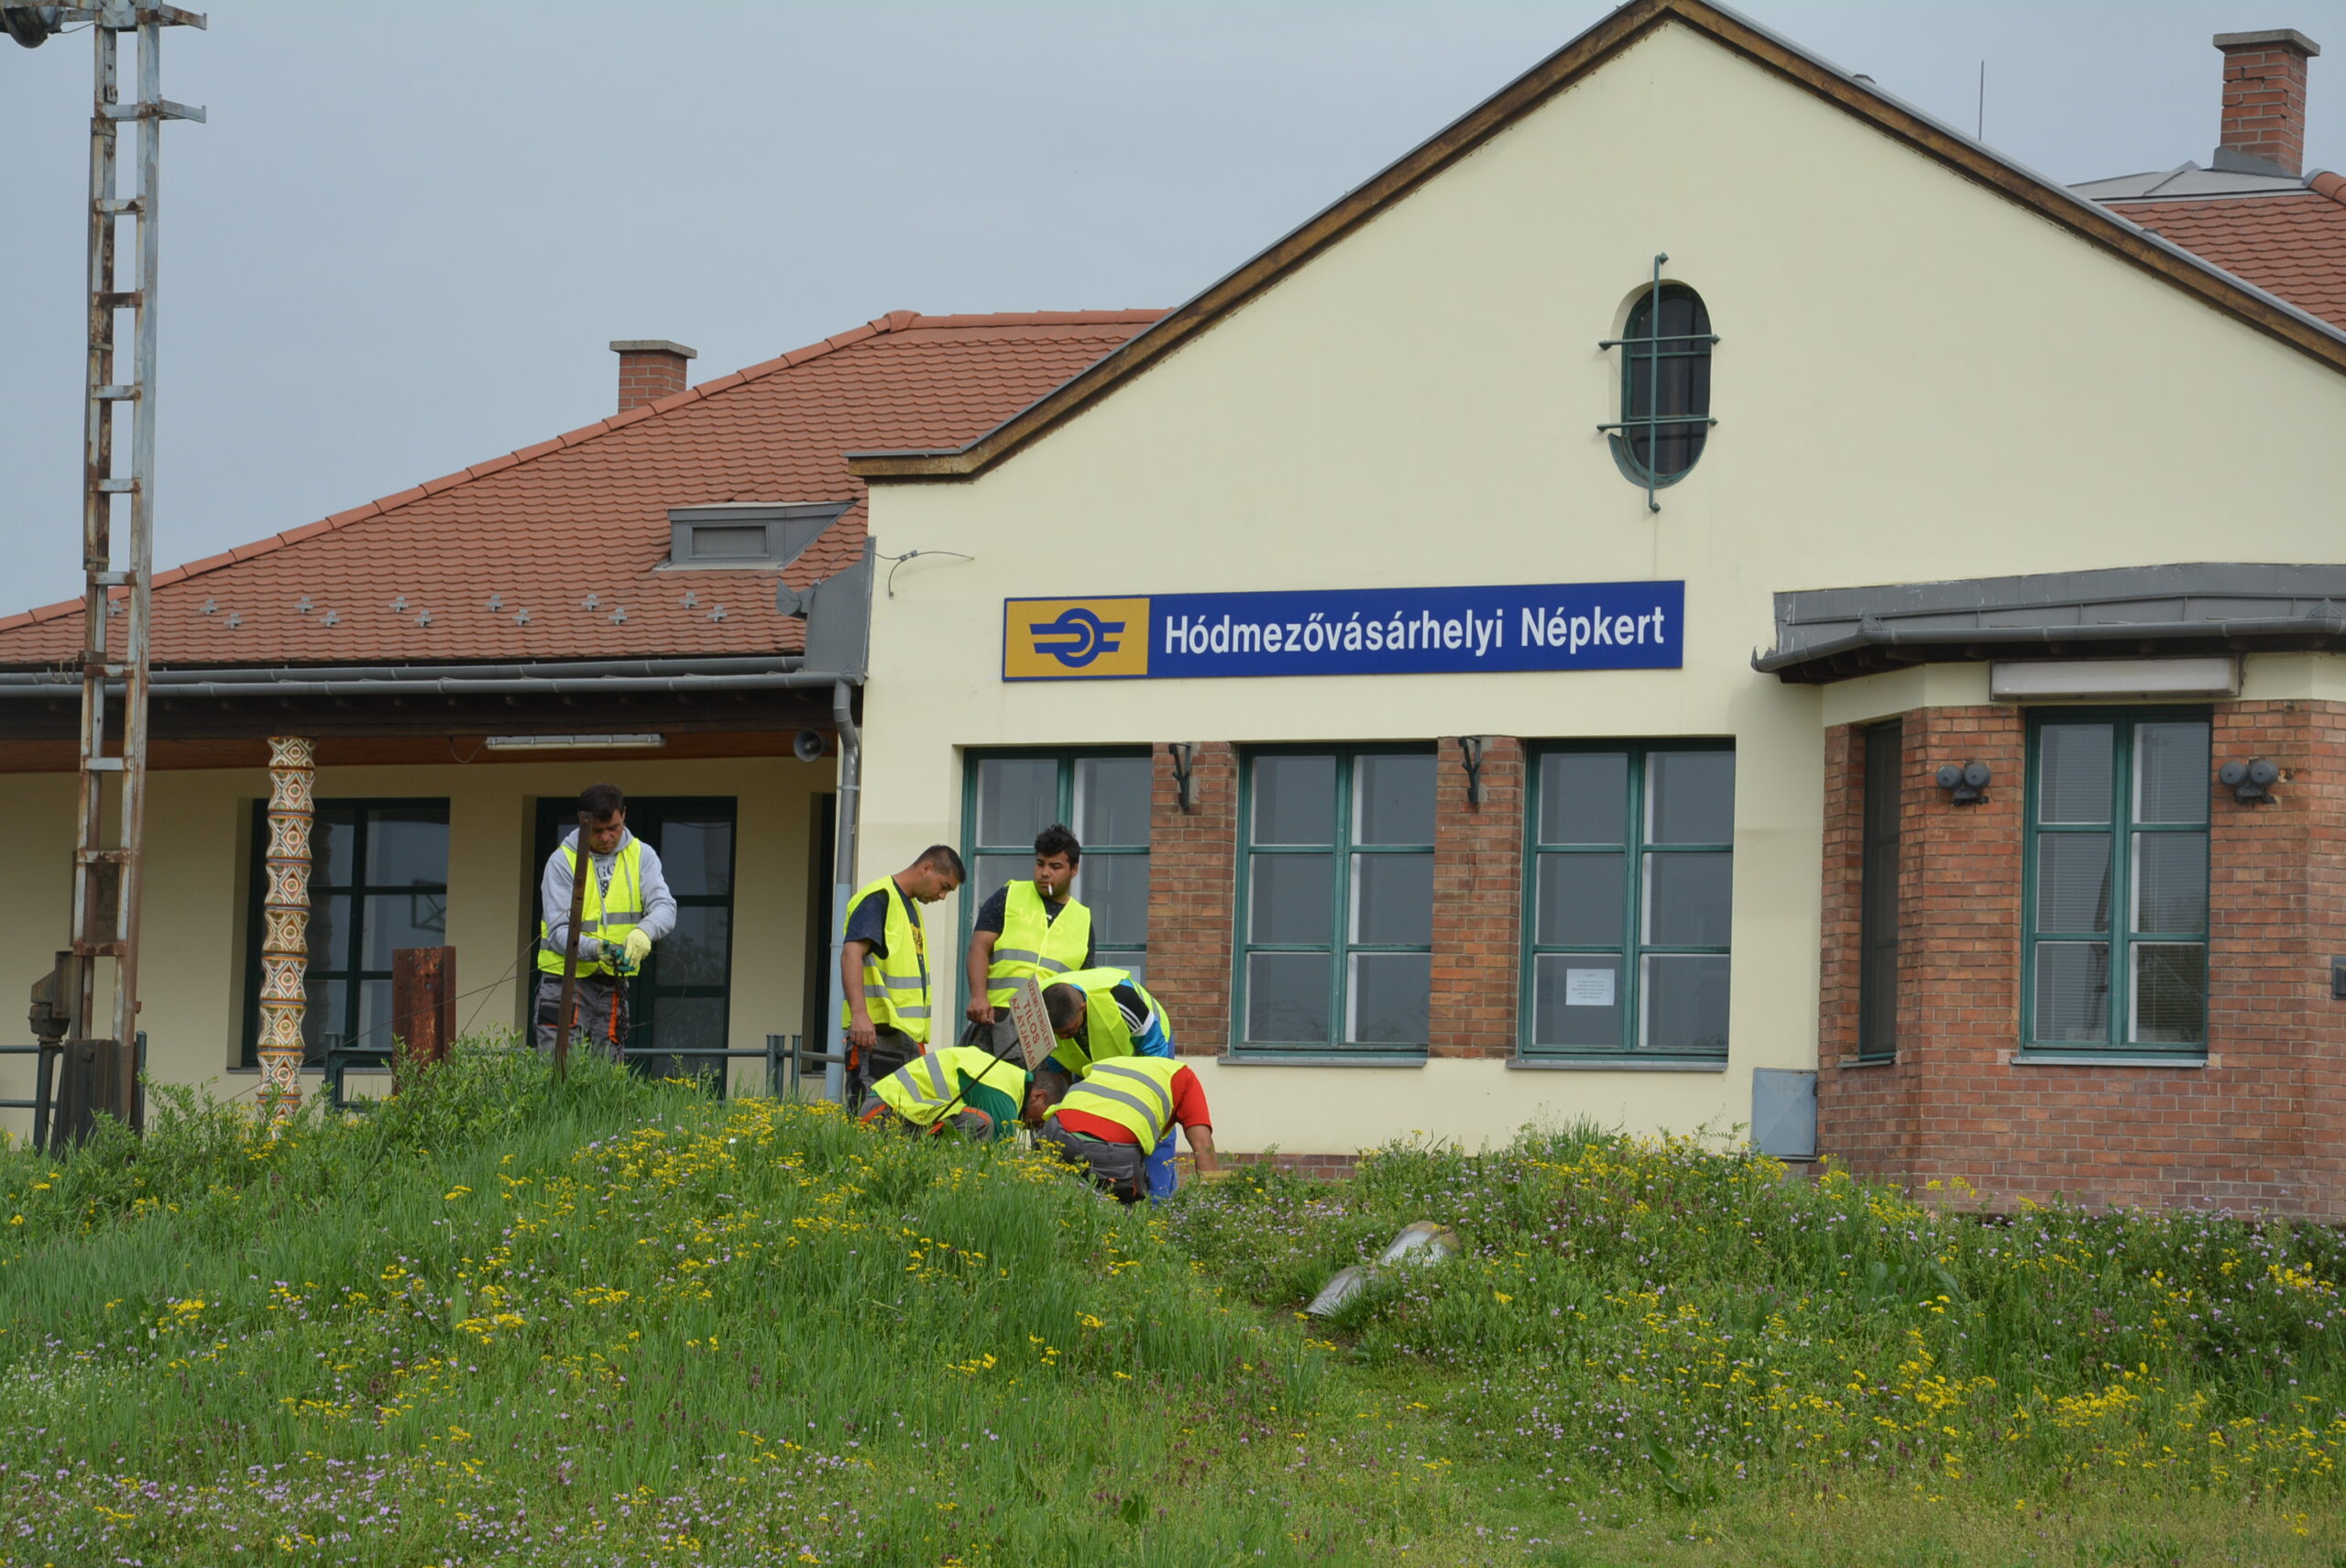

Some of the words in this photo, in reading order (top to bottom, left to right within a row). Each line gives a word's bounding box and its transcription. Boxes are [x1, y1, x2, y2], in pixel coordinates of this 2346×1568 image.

[1166, 609, 1503, 657] Hódmezővásárhelyi
[1521, 606, 1664, 654] Népkert
[1011, 997, 1020, 1013] AZ
[1024, 999, 1040, 1045] TILOS
